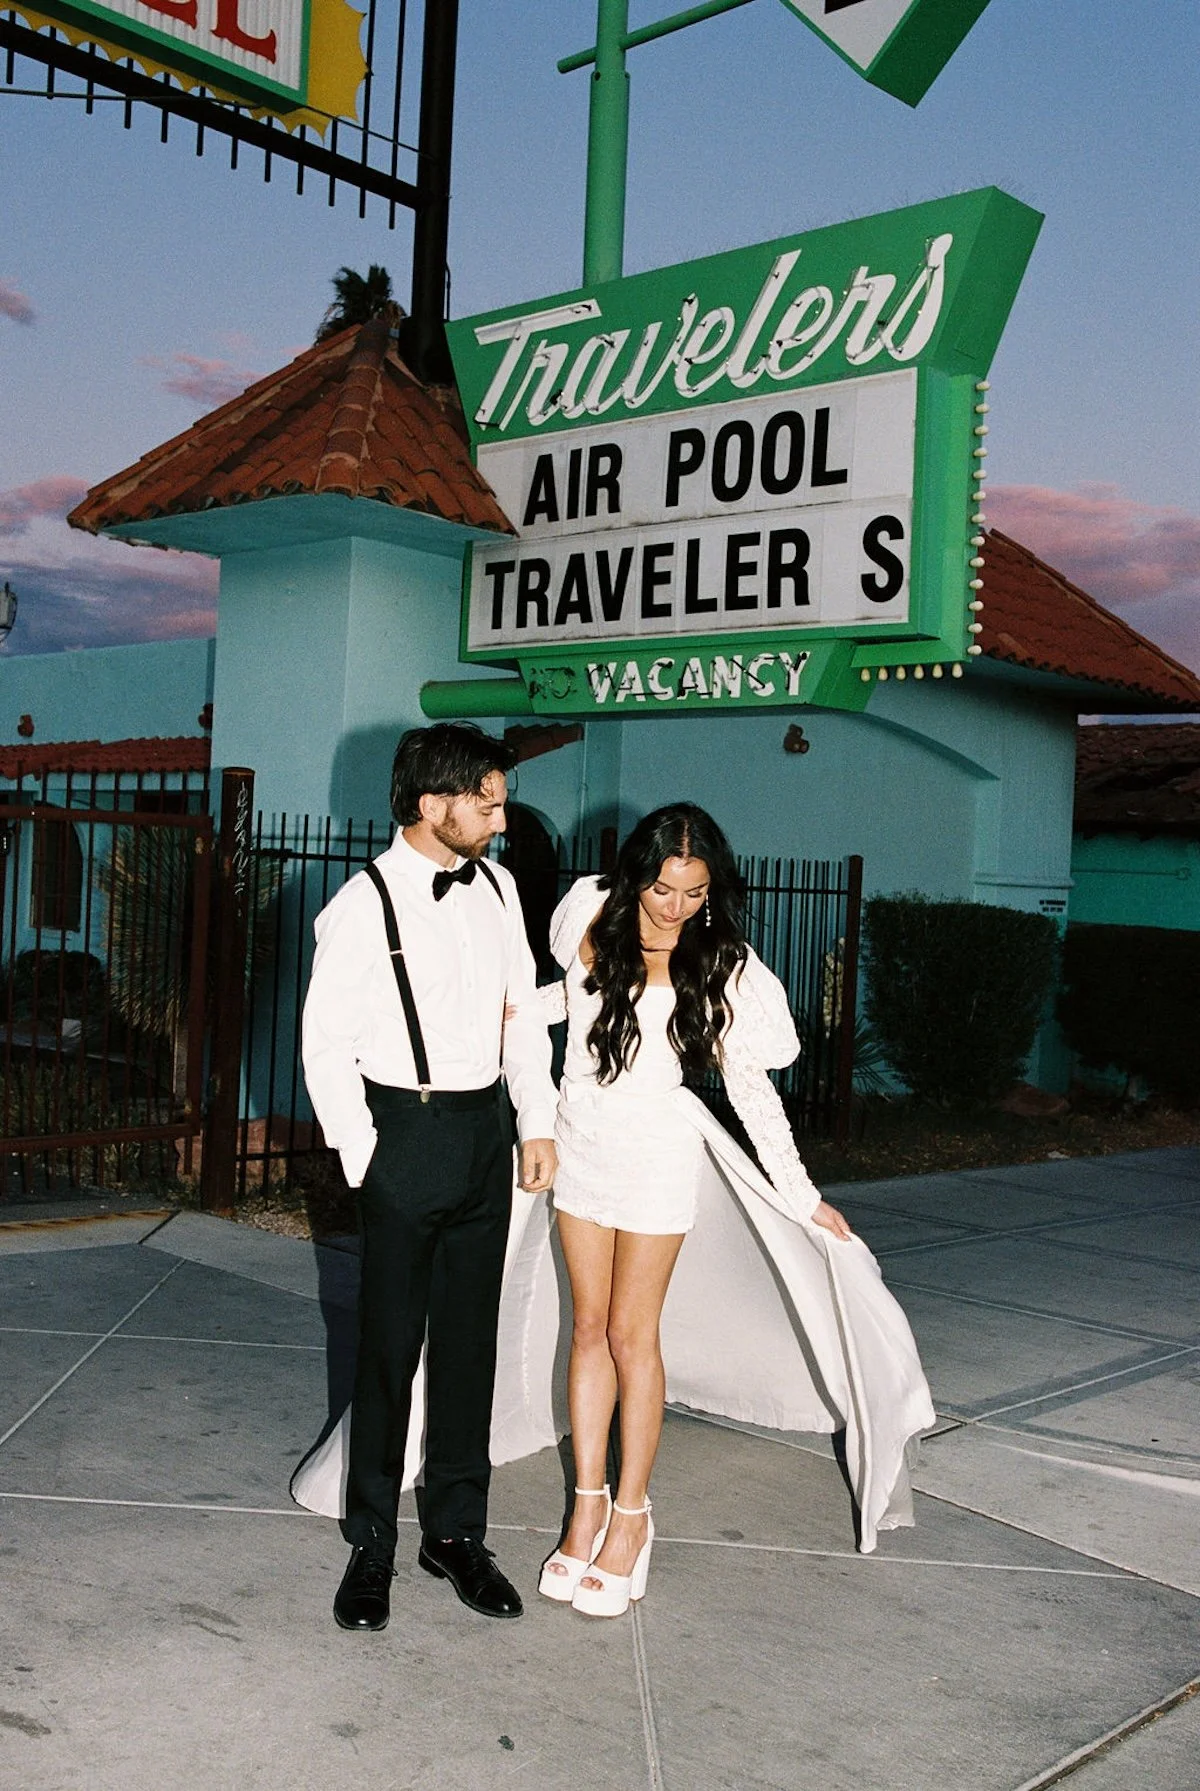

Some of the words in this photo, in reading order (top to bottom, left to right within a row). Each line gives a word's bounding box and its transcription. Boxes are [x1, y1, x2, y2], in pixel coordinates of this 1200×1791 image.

[474, 233, 954, 431] Travelers
[523, 443, 623, 527] AIR
[665, 407, 849, 509] POOL
[485, 527, 811, 630] TRAVELER
[588, 651, 811, 703] VACANCY
